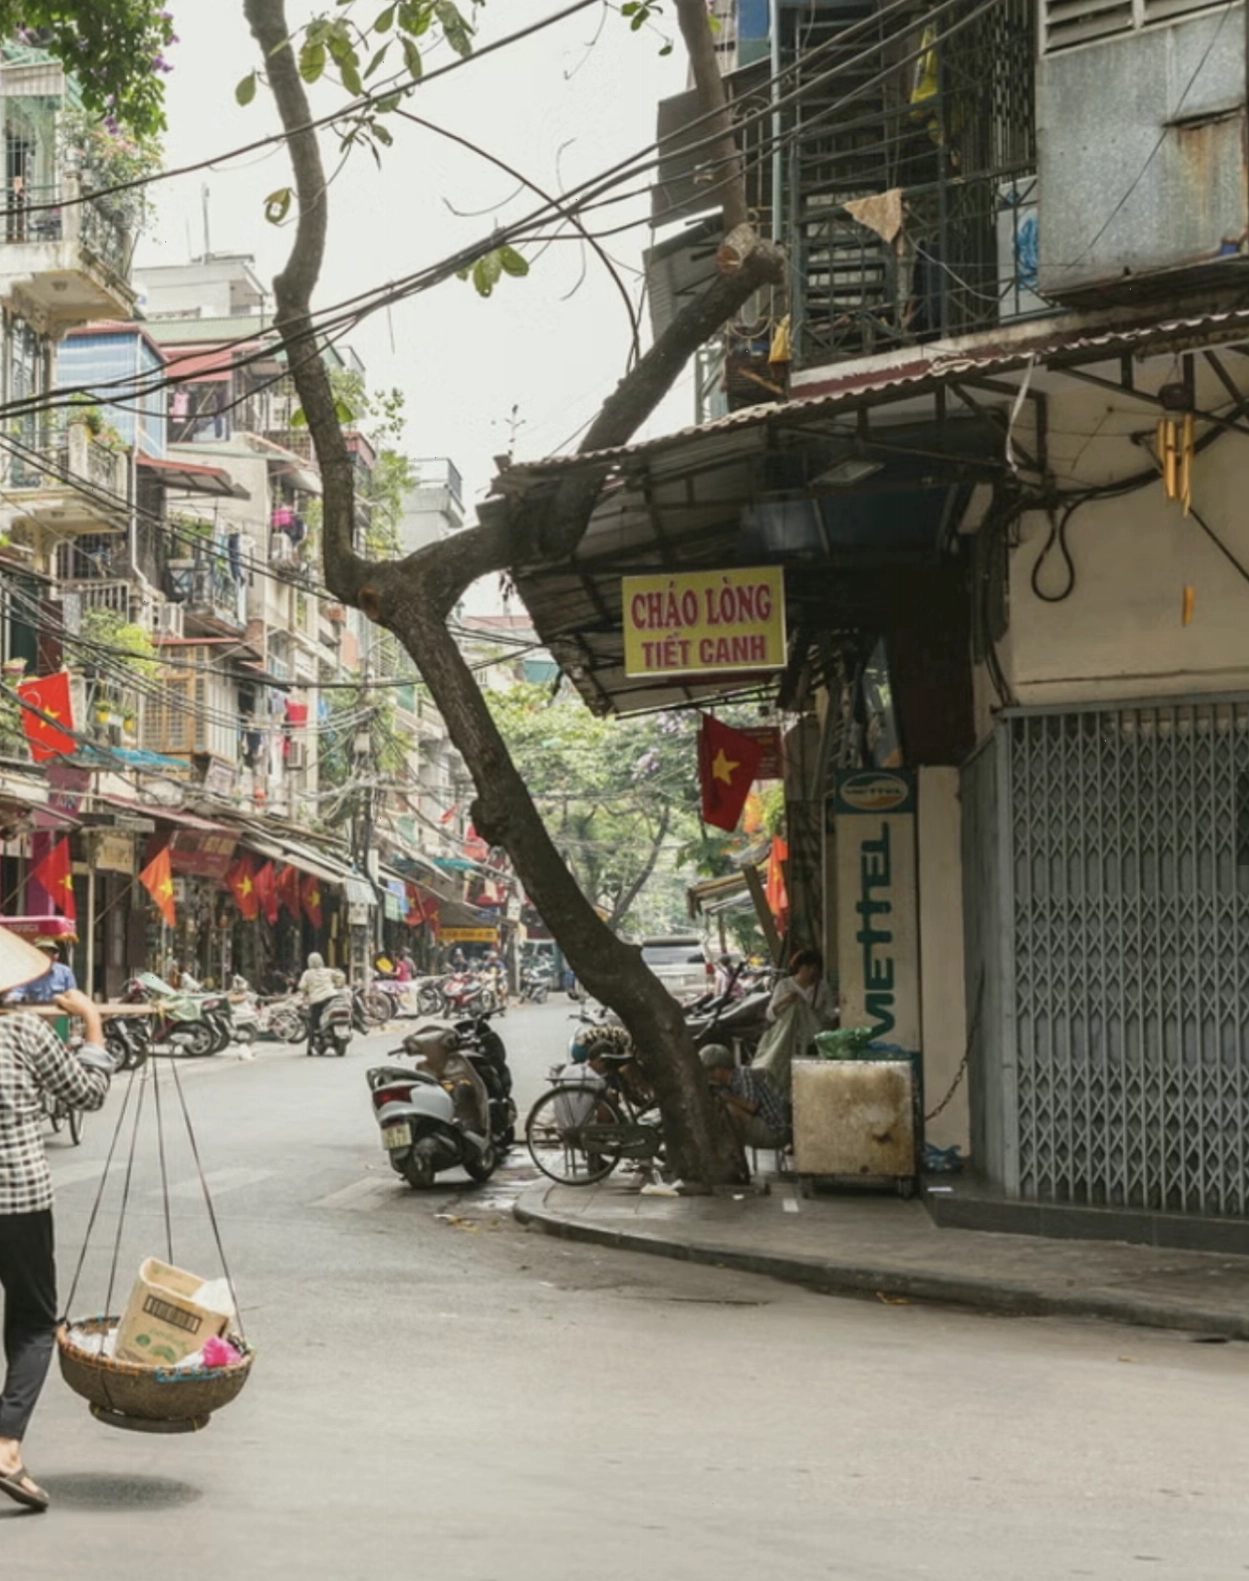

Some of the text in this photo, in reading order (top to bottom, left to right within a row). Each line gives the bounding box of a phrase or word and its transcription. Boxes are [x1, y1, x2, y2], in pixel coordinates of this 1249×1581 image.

[631, 576, 773, 630] CHÁO LÒNG
[641, 631, 766, 668] TIẾT CANH
